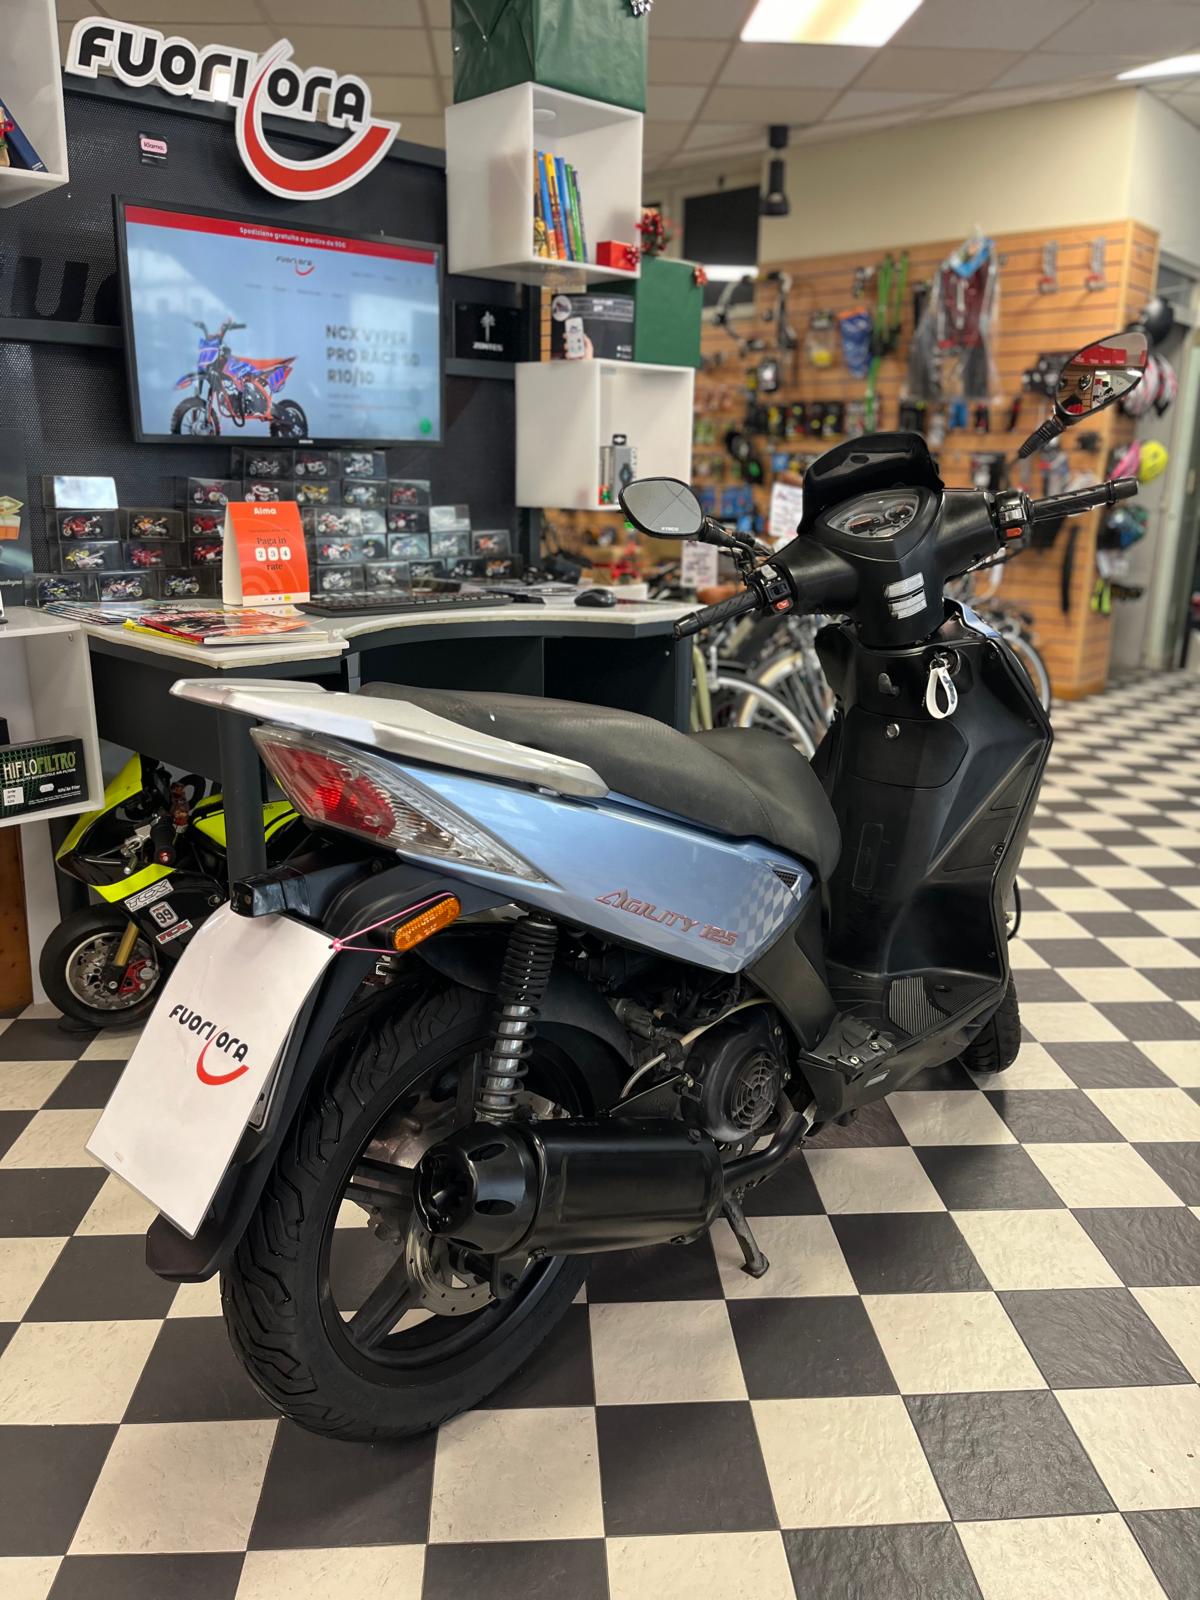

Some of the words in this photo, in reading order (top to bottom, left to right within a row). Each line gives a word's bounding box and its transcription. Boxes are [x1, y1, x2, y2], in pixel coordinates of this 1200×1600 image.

[254, 507, 277, 515] Alma
[256, 537, 277, 546] Paga
[155, 907, 174, 924] 99
[700, 923, 738, 946] 125
